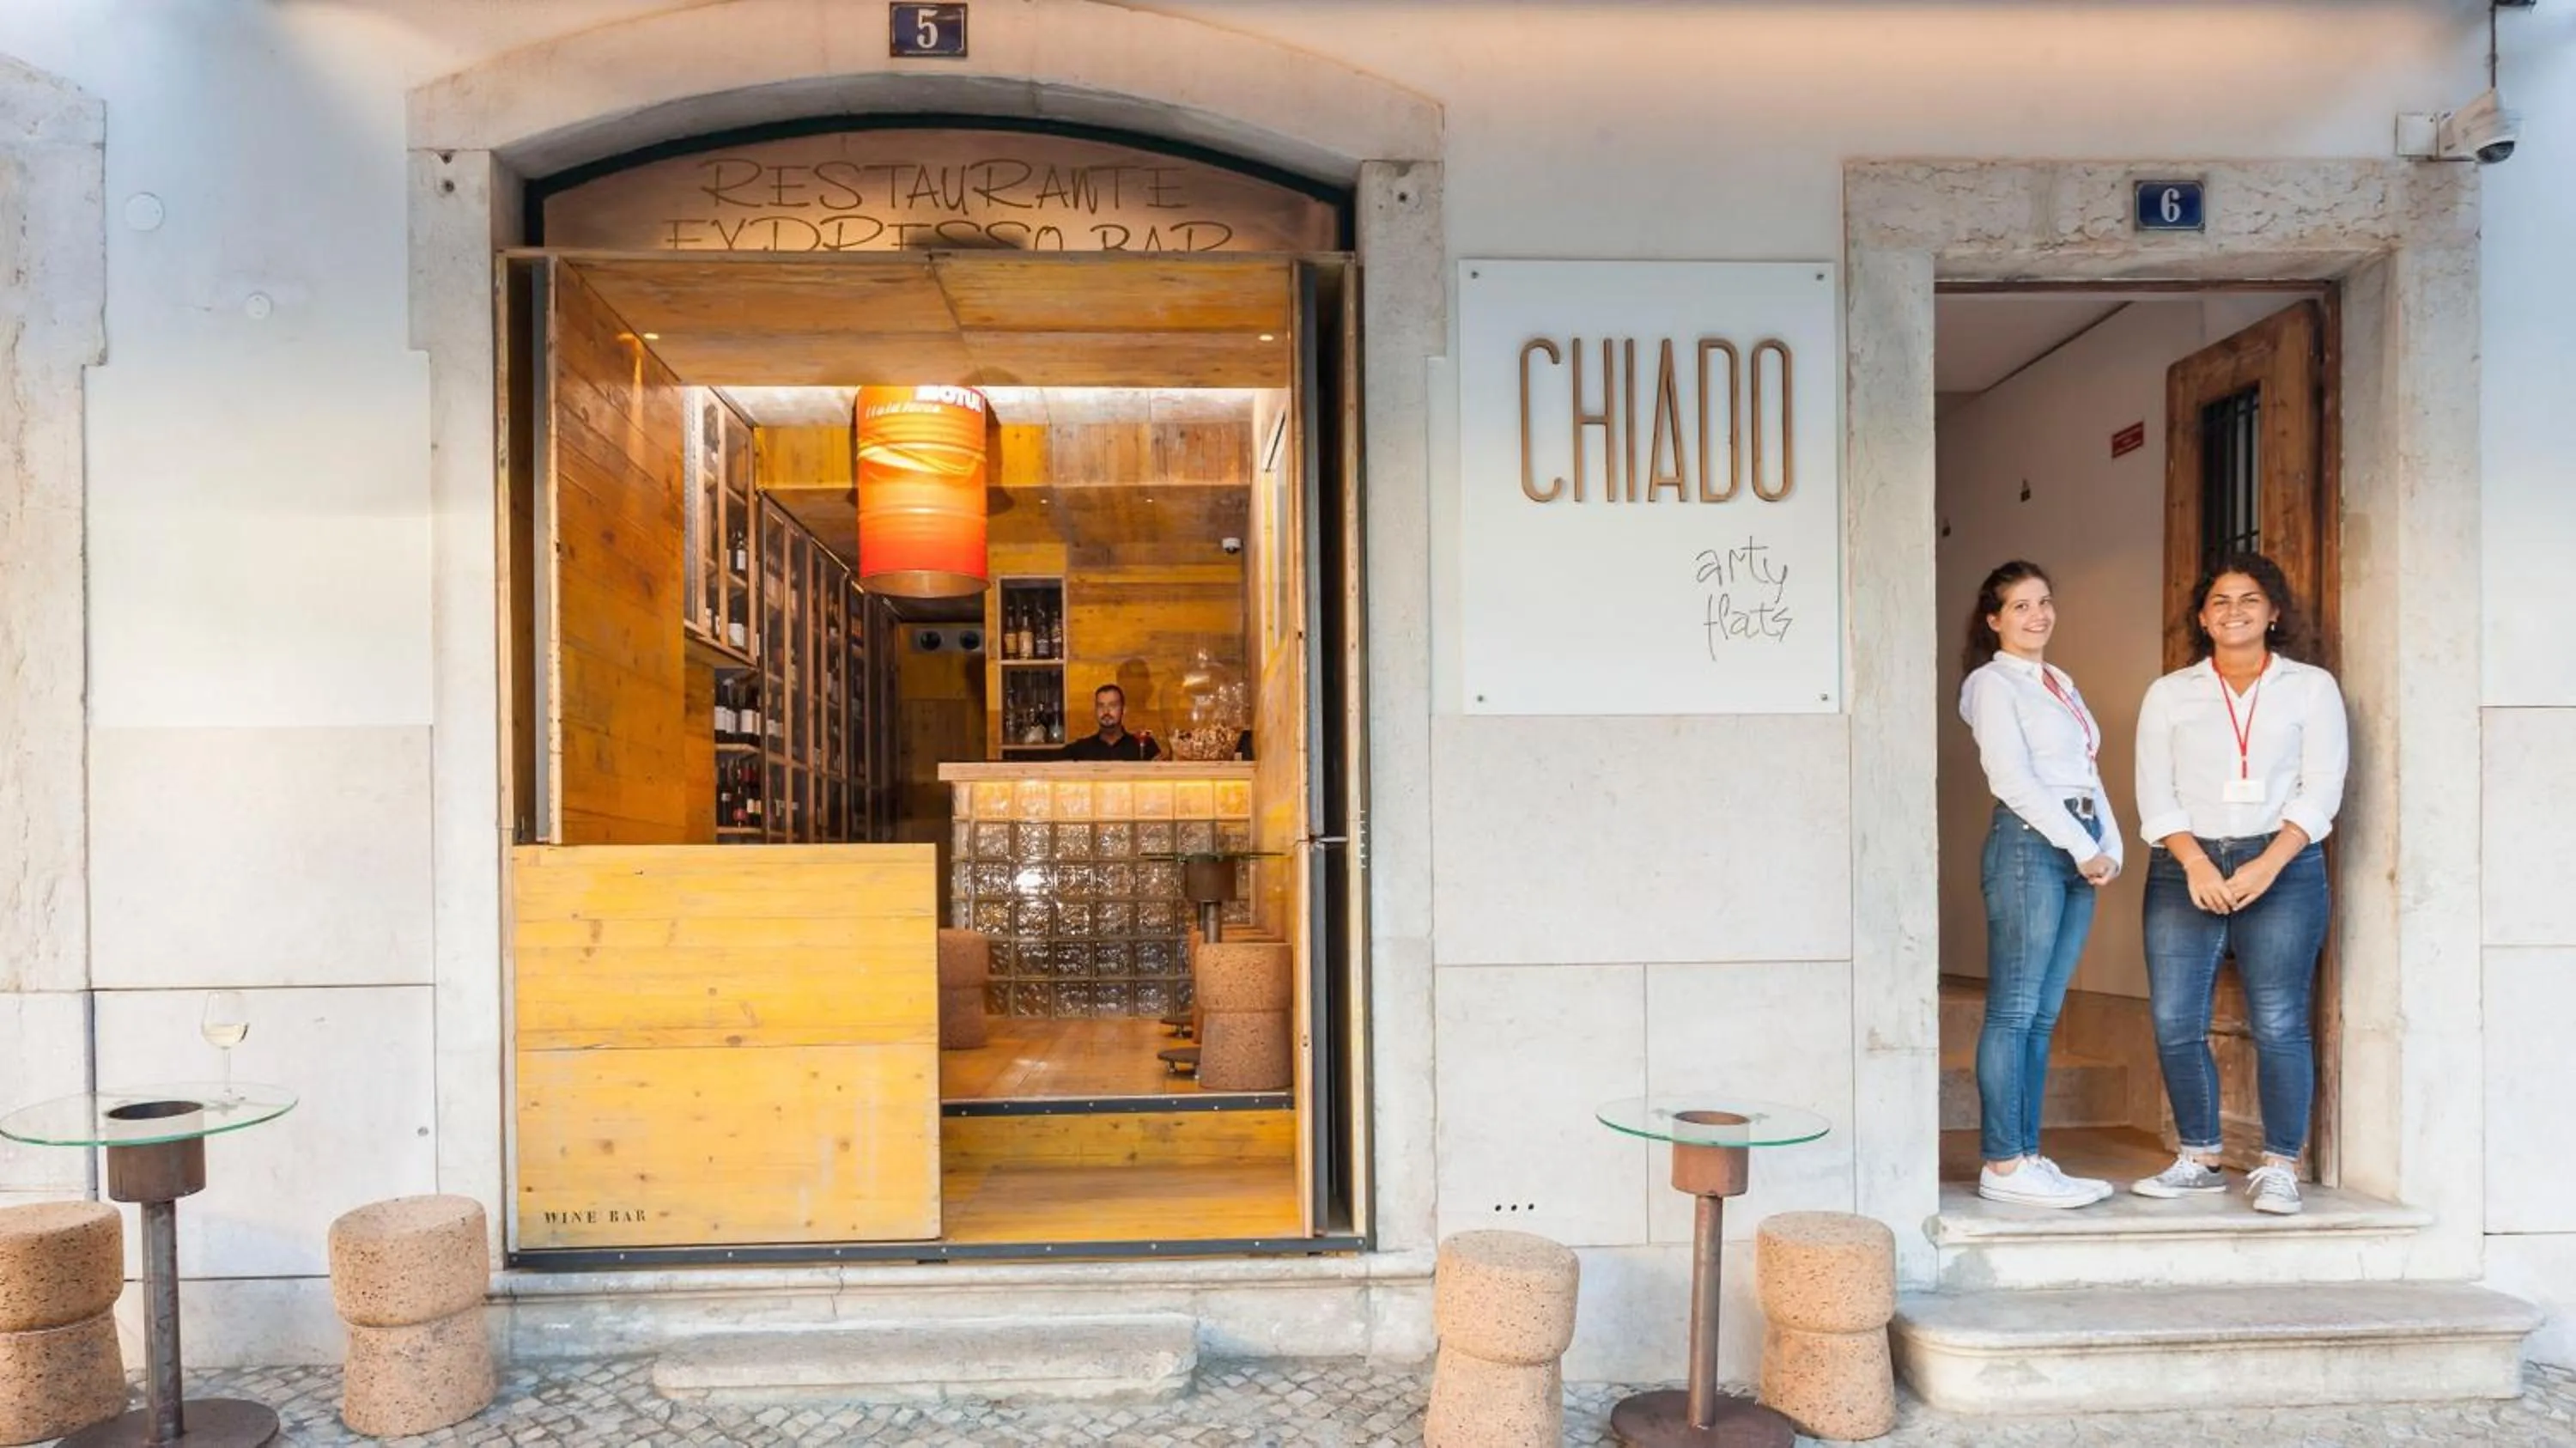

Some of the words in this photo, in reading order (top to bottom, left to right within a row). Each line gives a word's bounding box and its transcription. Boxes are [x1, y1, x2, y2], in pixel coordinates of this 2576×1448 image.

[916, 8, 939, 49] 5
[700, 159, 1189, 216] RESTAURANTE
[2160, 188, 2181, 222] 6
[1518, 337, 1795, 503] CHIADO
[1696, 535, 1788, 603] arty
[1703, 593, 1793, 660] flats
[544, 1210, 598, 1224] WINE
[609, 1209, 646, 1223] BAR
